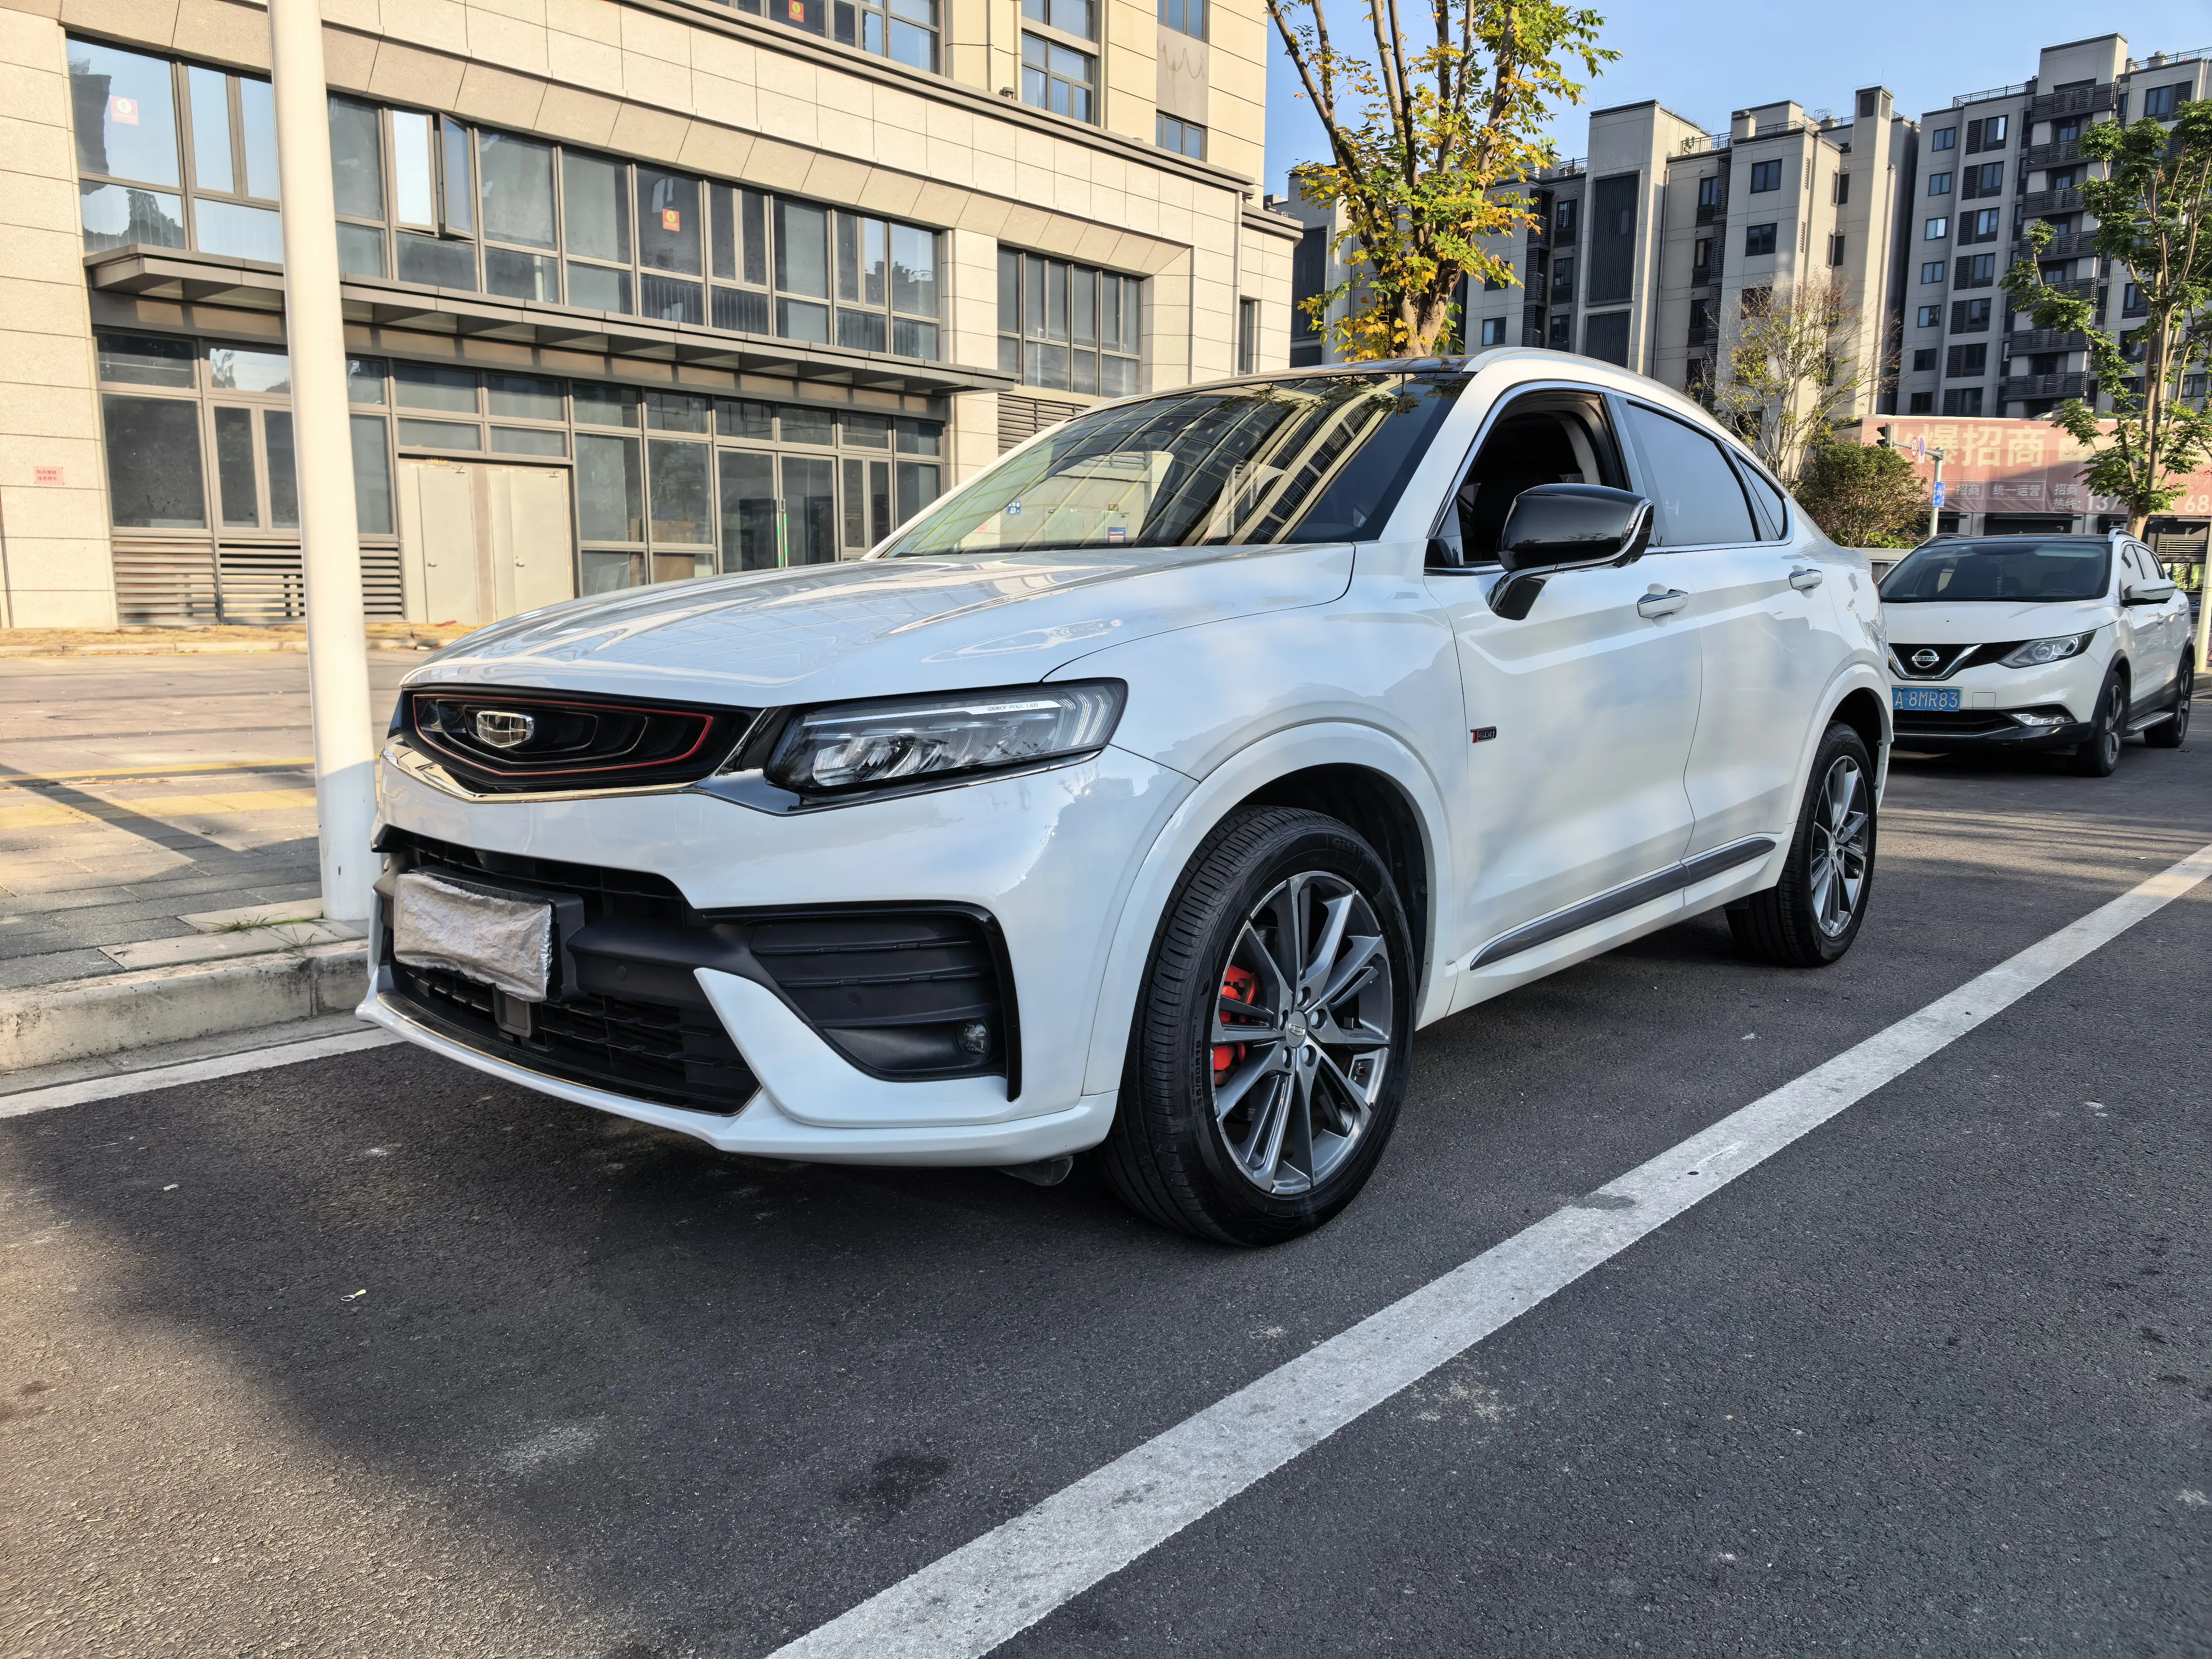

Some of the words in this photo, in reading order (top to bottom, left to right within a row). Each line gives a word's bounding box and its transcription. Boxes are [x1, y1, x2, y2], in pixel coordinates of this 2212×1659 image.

[1993, 484, 2041, 496] 统一运营
[2054, 483, 2078, 495] 招商
[2185, 495, 2212, 512] 68
